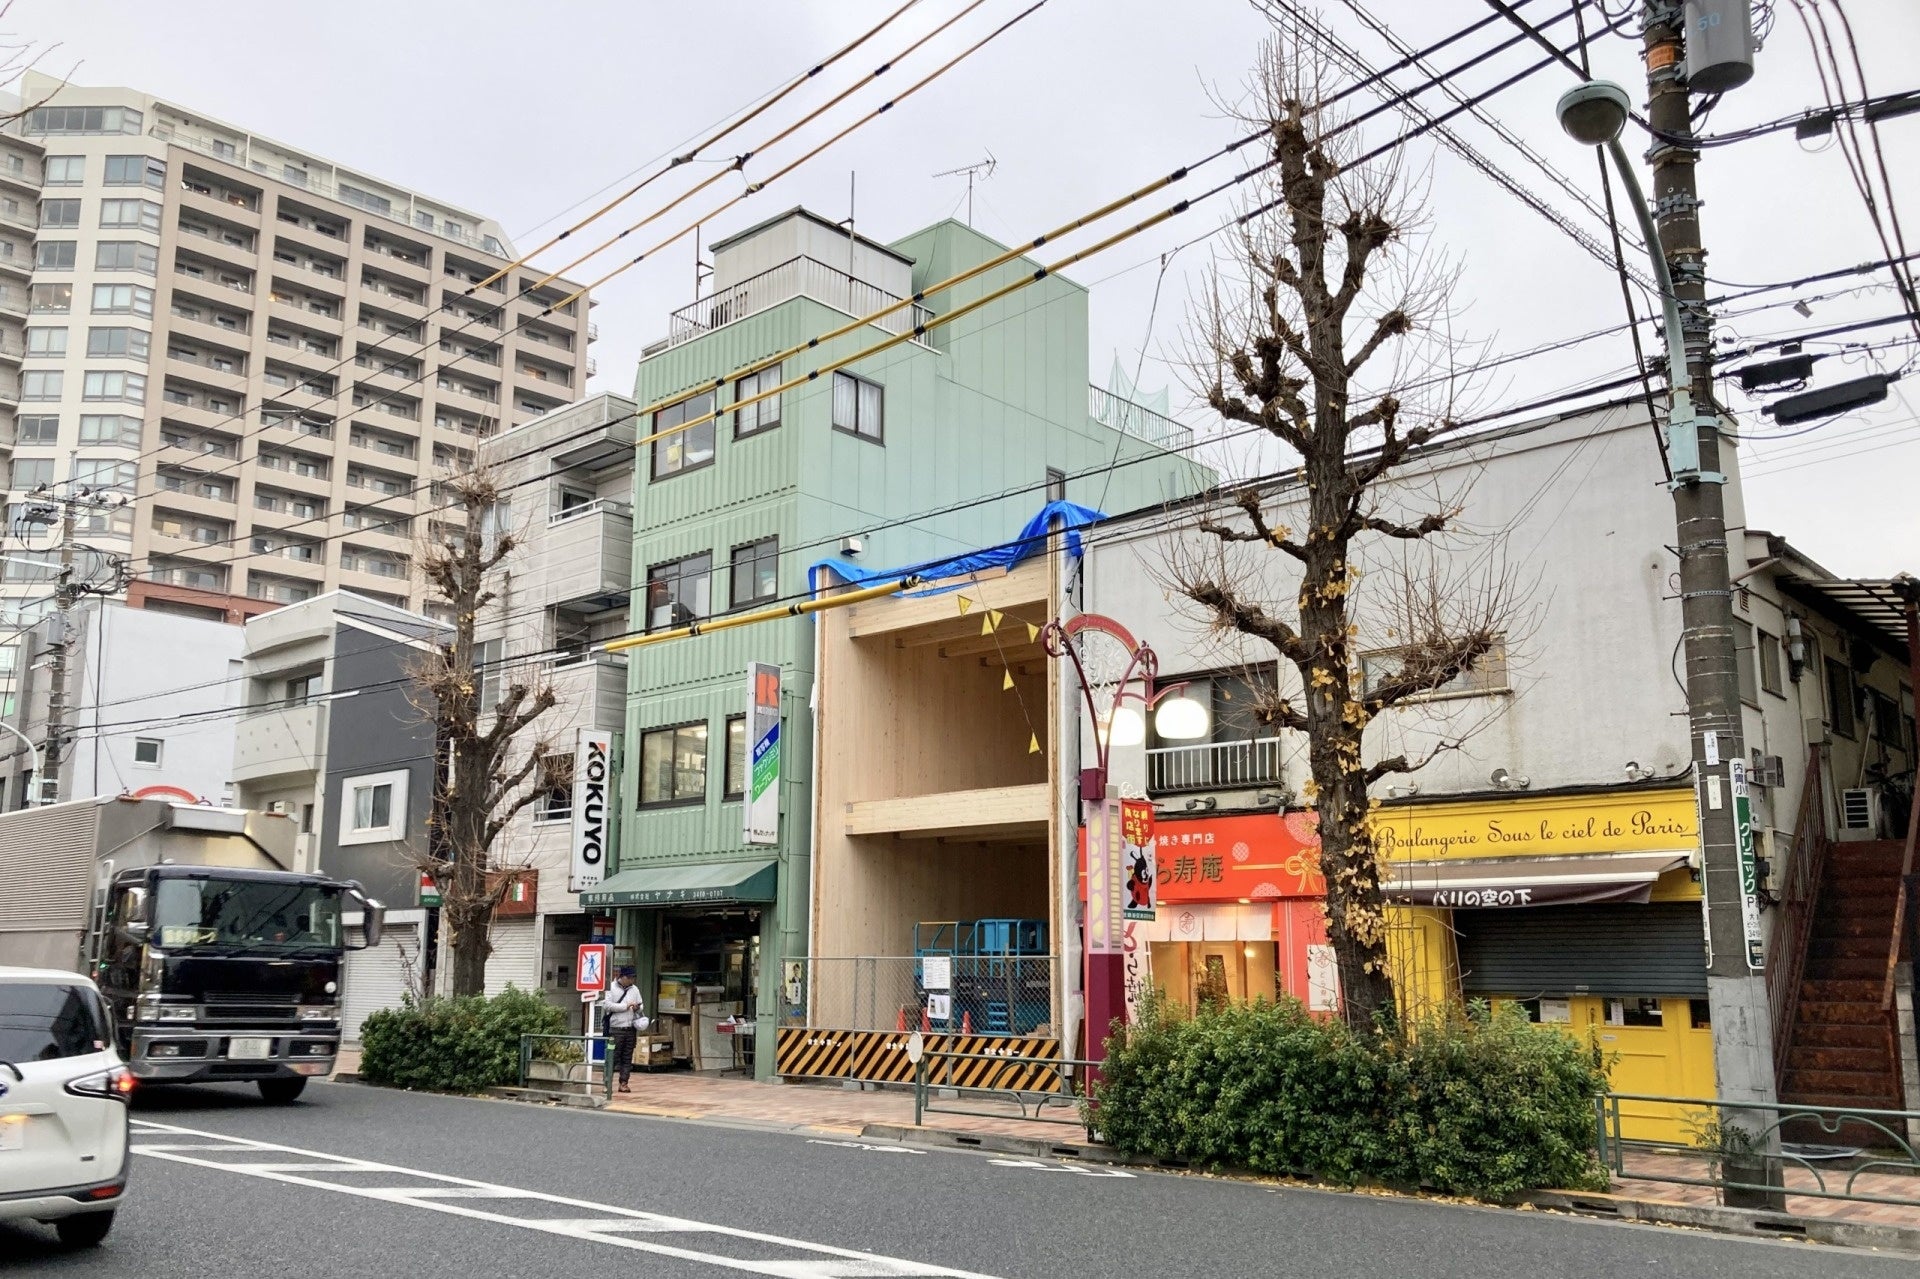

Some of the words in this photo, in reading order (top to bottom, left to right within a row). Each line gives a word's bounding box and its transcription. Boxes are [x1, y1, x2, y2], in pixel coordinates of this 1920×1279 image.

[1698, 12, 1721, 31] 50
[754, 771, 772, 795] ワープロ
[583, 741, 607, 865] KOKUYO
[1379, 825, 1480, 855] Boulangerie
[1487, 819, 1535, 843] Sous
[1540, 819, 1559, 841] le
[1562, 817, 1598, 839] ciel
[1602, 819, 1625, 838] de
[1631, 810, 1690, 836] Paris
[1739, 822, 1755, 894] クリニック
[1432, 887, 1533, 907] パリの空の下
